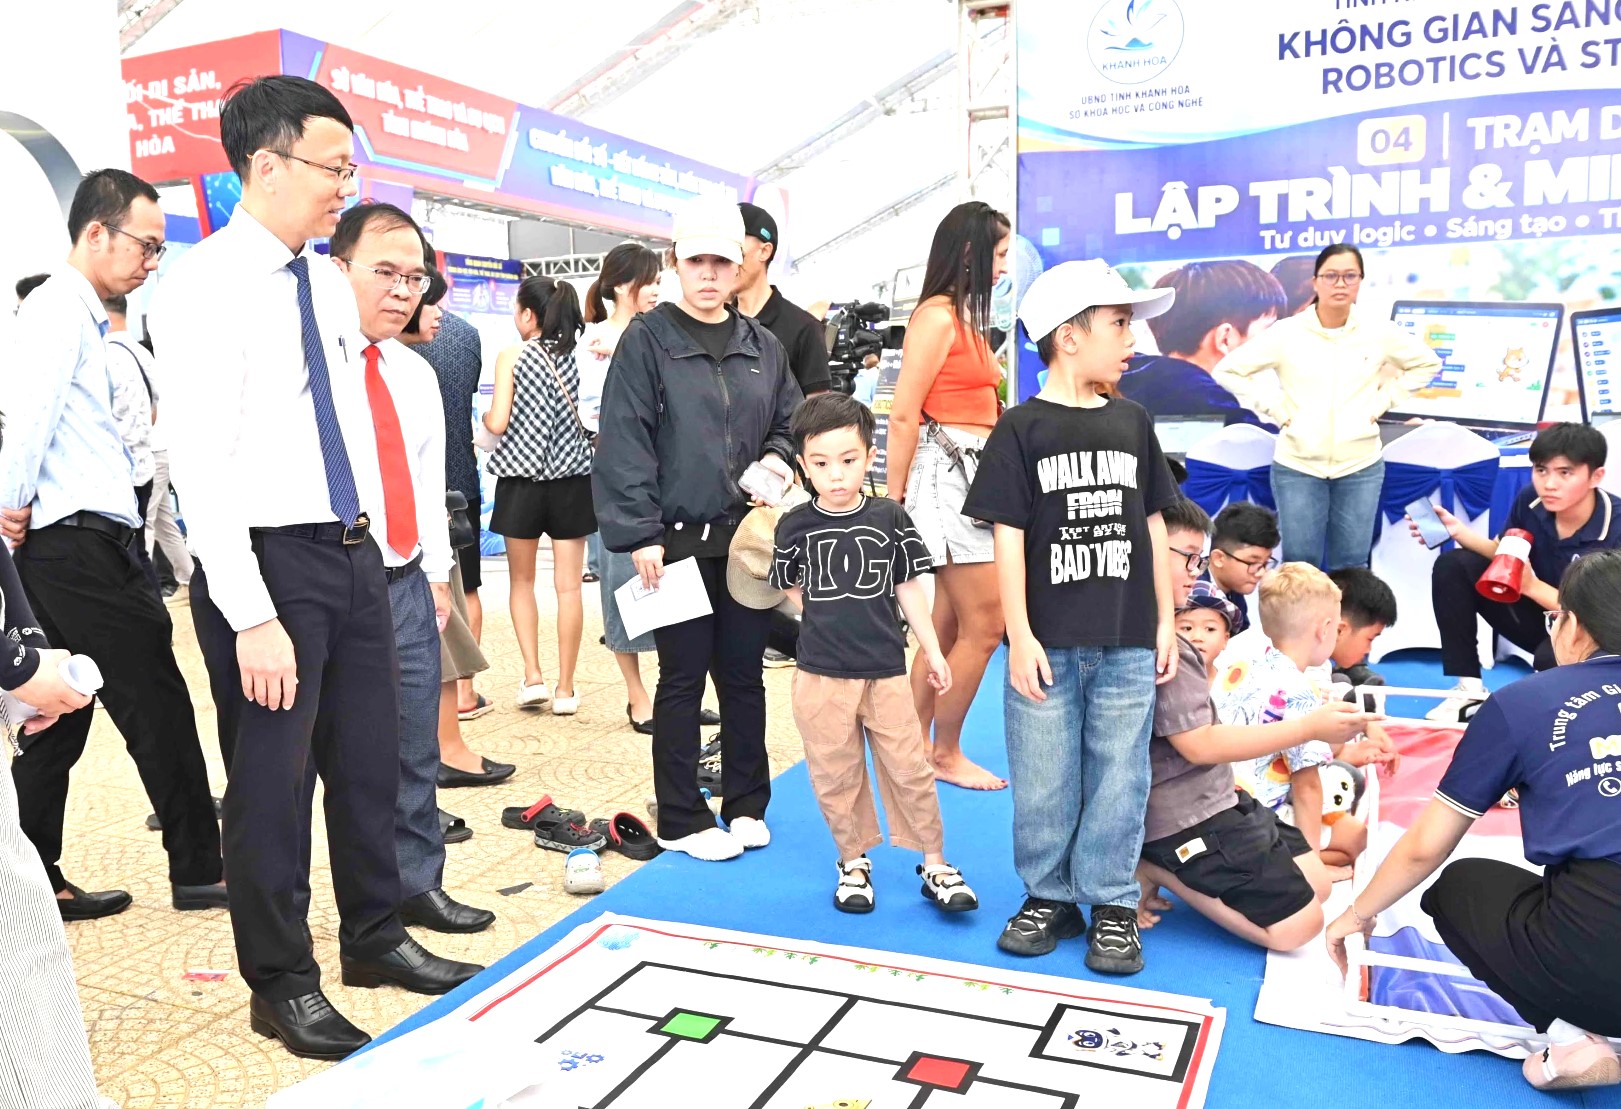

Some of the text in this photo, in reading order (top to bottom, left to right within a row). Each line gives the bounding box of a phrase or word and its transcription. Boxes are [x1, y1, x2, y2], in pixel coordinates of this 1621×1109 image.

[1279, 19, 1412, 60] KHÔNG
[1423, 7, 1518, 44] GIAN
[1322, 50, 1506, 94] ROBOTICS
[1518, 37, 1568, 75] VÀ
[1370, 126, 1413, 154] 04
[1467, 107, 1590, 155] TRẠM
[1115, 180, 1240, 240] LẬP
[1249, 165, 1451, 225] TRÌNH
[1462, 163, 1515, 210] &
[1259, 229, 1293, 250] Tư
[1298, 226, 1347, 248] duy
[1353, 220, 1416, 247] logic
[1446, 215, 1513, 240] Sáng
[1520, 213, 1567, 238] tạo
[1037, 451, 1096, 494] WALK
[1050, 543, 1091, 584] BAD
[1549, 708, 1578, 752] Trung
[1564, 690, 1602, 709] tâm
[1565, 767, 1591, 787] Năng
[1593, 762, 1613, 777] lực
